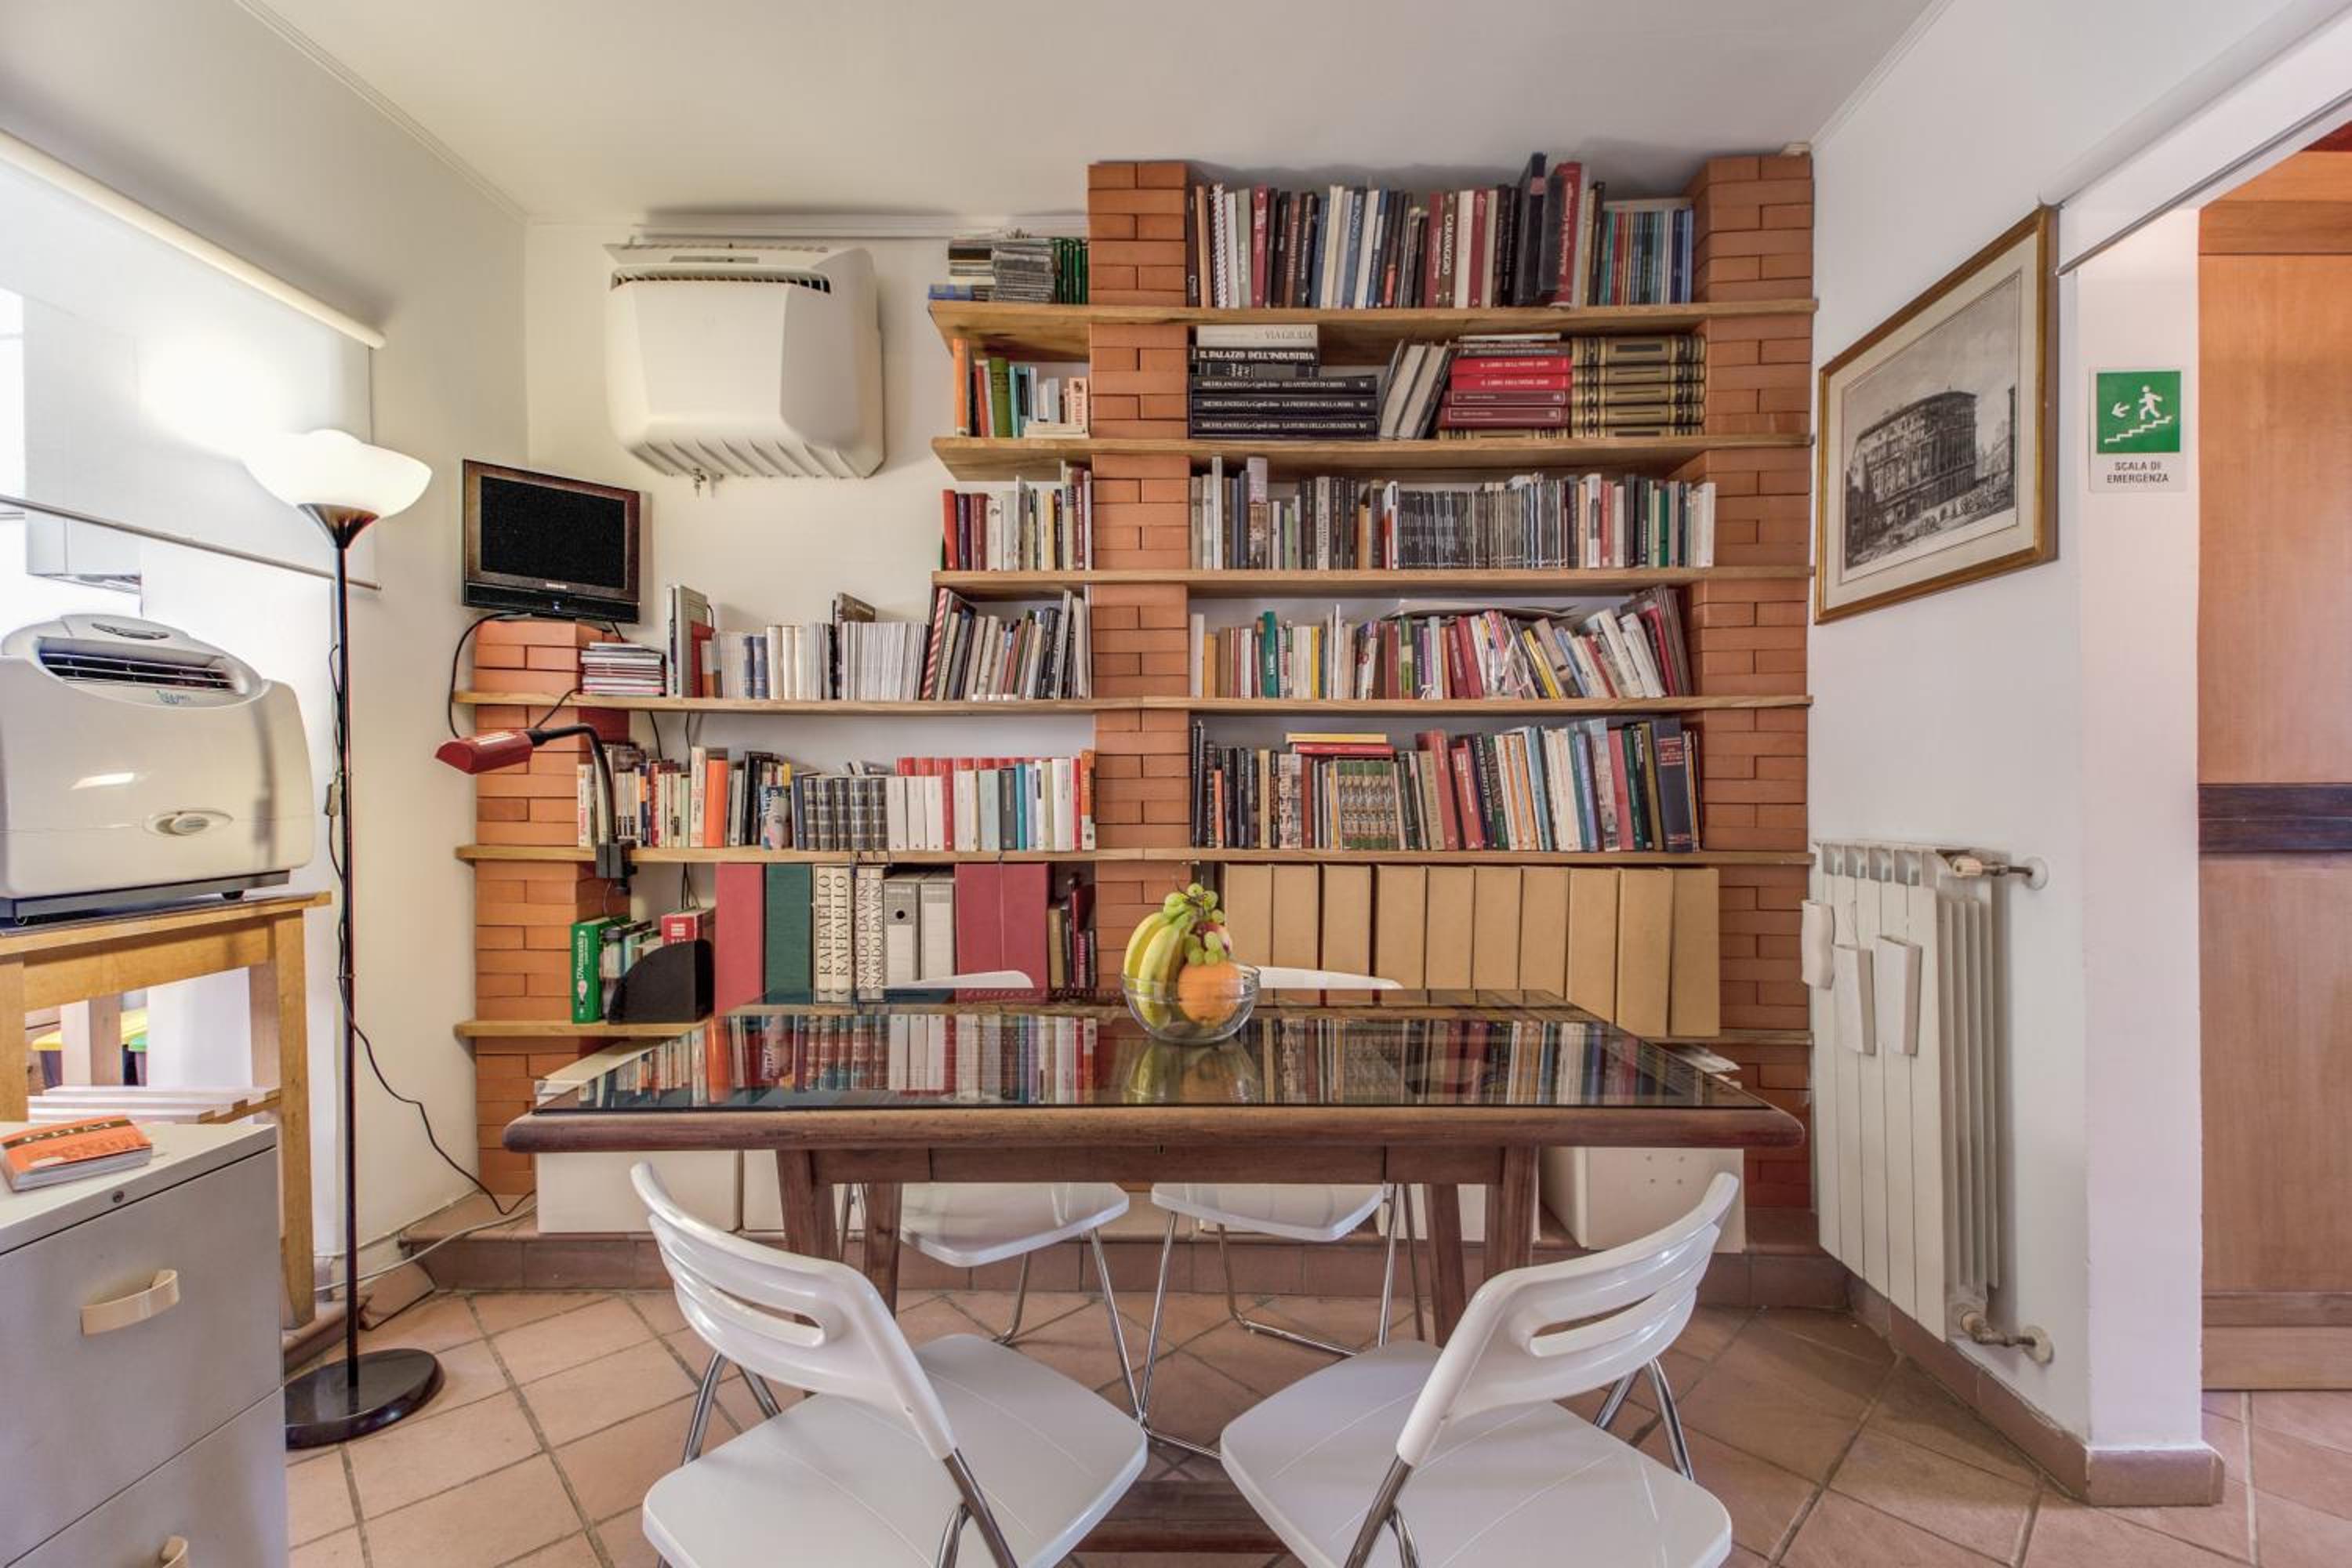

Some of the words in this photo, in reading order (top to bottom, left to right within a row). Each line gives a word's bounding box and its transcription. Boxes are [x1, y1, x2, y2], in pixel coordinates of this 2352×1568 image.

[1443, 214, 1454, 275] CARAVAGGIO
[2107, 473, 2169, 484] EMERGENZA
[2114, 461, 2147, 471] SCALA
[2151, 461, 2161, 470] DI
[818, 875, 832, 975] RAFFAELLO
[834, 876, 848, 976] RAFFAELLO
[858, 937, 869, 990] NARDO
[871, 937, 883, 990] NARDO
